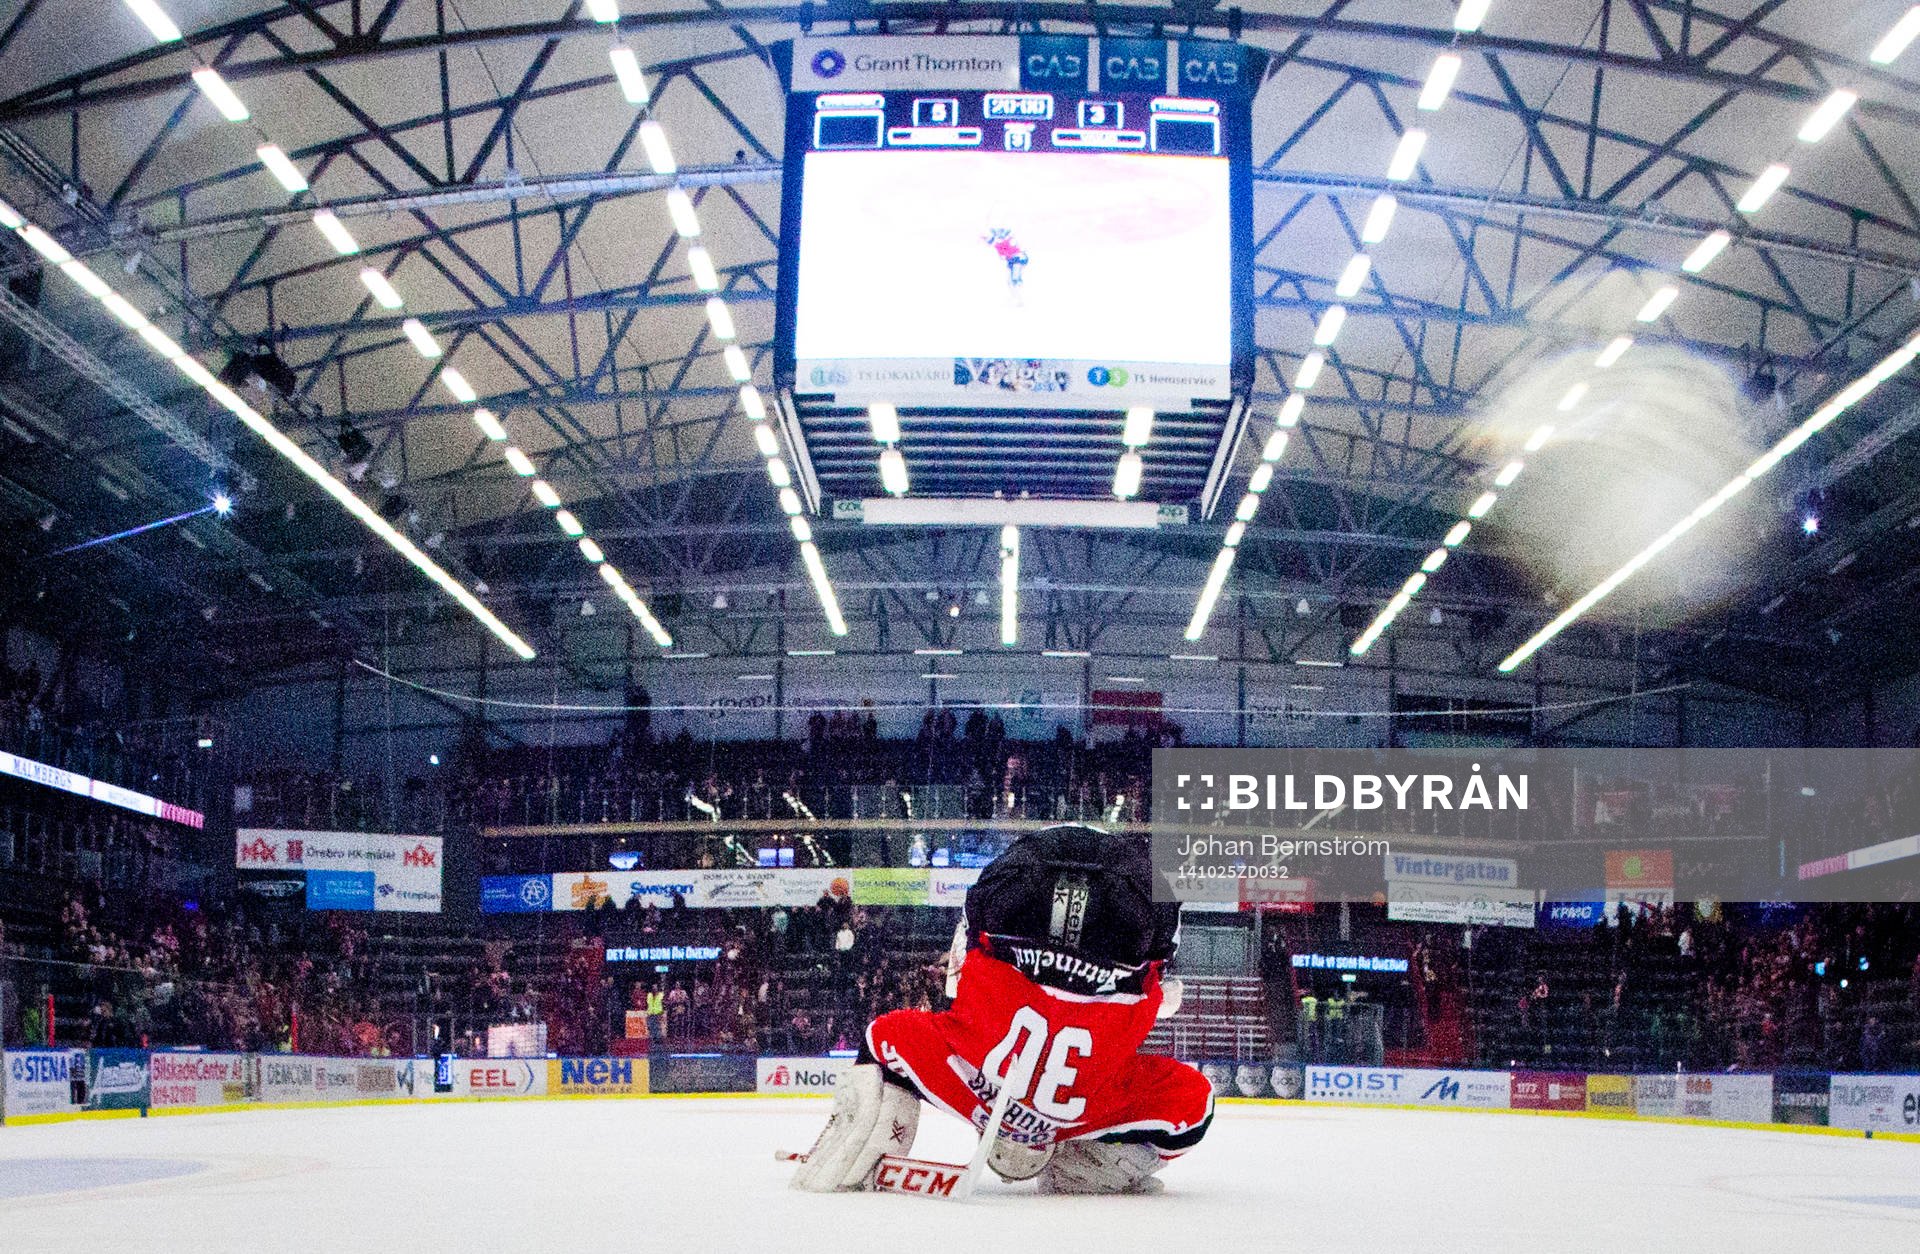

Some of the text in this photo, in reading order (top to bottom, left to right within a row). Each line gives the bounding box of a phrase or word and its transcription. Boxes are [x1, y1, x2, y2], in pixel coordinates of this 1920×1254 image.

[854, 53, 1002, 72] Grant Thornton
[241, 837, 277, 863] MAX
[403, 842, 436, 867] MAX
[1393, 856, 1510, 881] Vintergatan
[629, 881, 694, 896] Swegon
[1551, 906, 1592, 920] KPMG
[25, 1056, 69, 1083] STENA
[981, 1005, 1093, 1120] 30
[470, 1068, 517, 1087] EEL
[1312, 1072, 1404, 1091] HOIST
[876, 1164, 960, 1196] CCM
